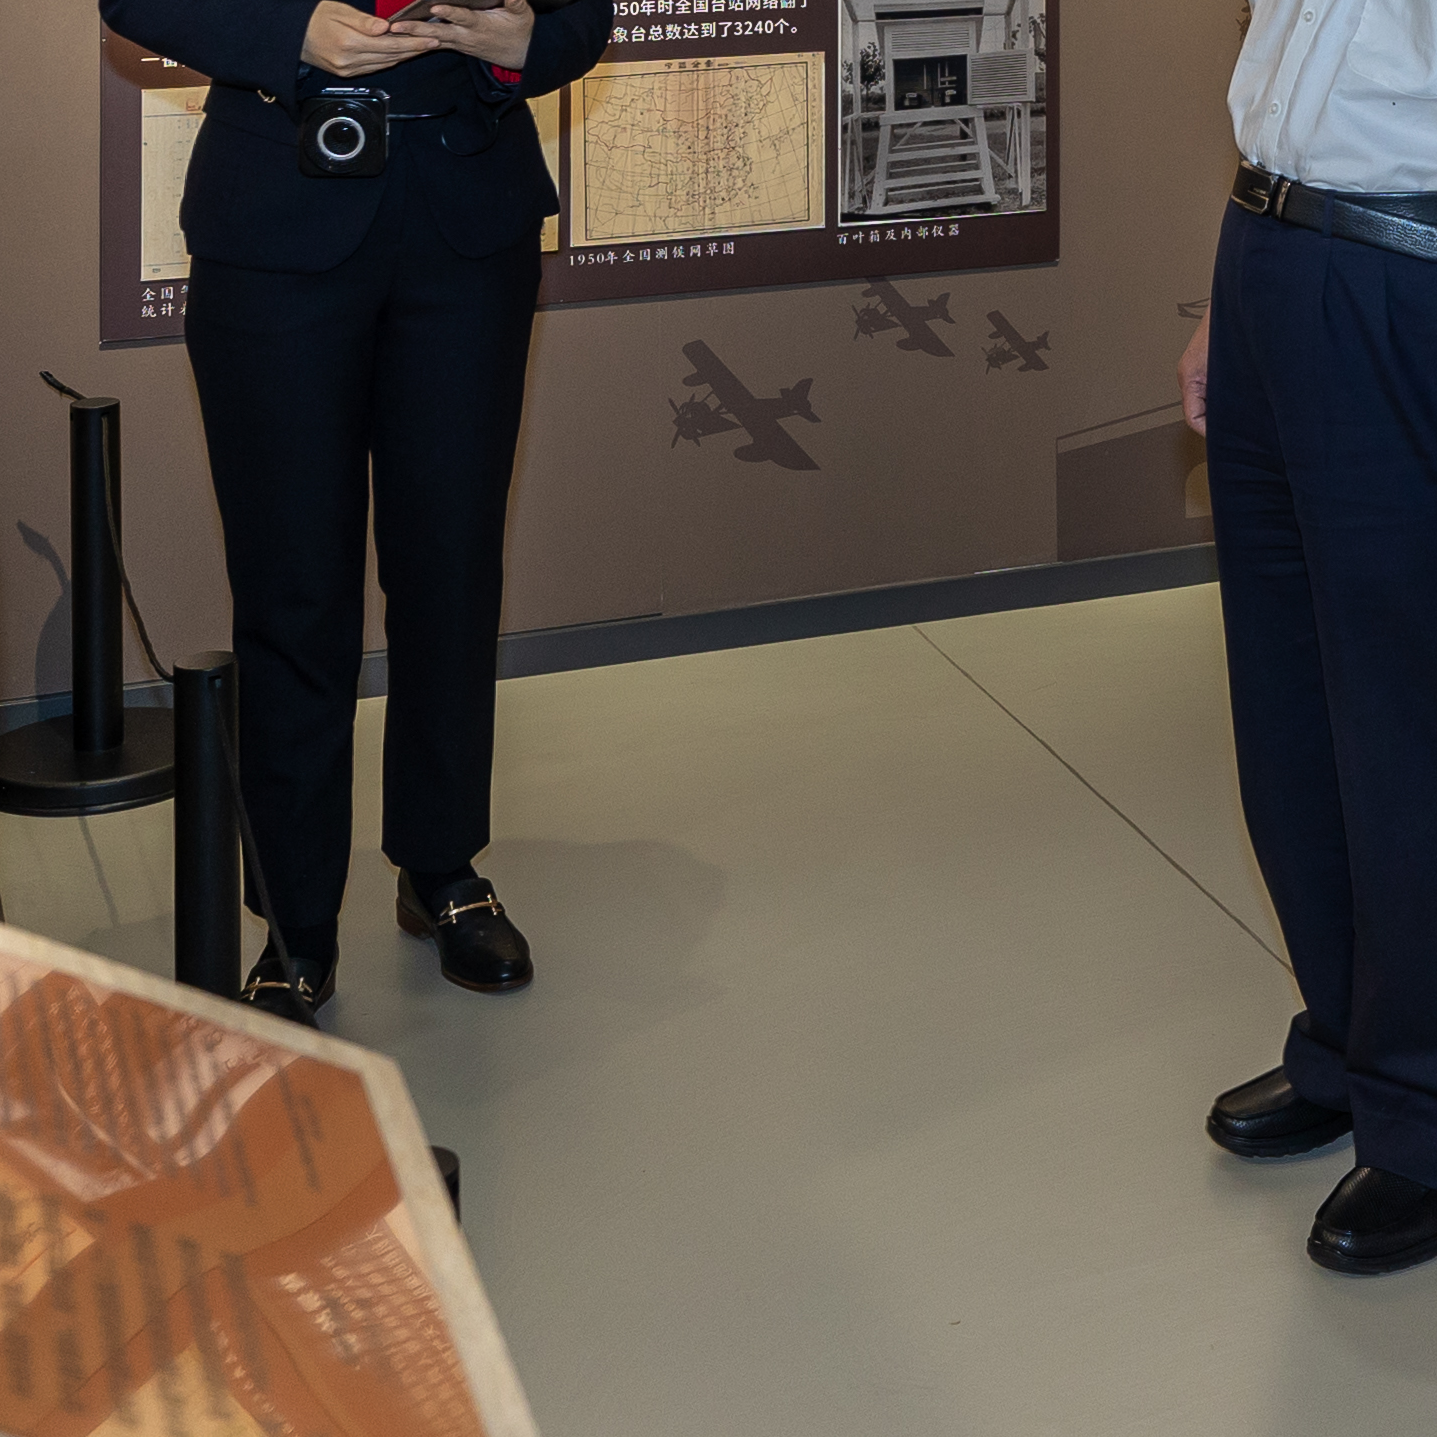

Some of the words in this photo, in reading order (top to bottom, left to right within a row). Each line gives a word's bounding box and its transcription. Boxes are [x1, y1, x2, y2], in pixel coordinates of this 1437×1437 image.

[607, 17, 798, 43] 象台总数达到了3240个。
[836, 223, 961, 246] 百叶箱及内部仪器
[568, 241, 736, 267] 1950年全国测候网草图
